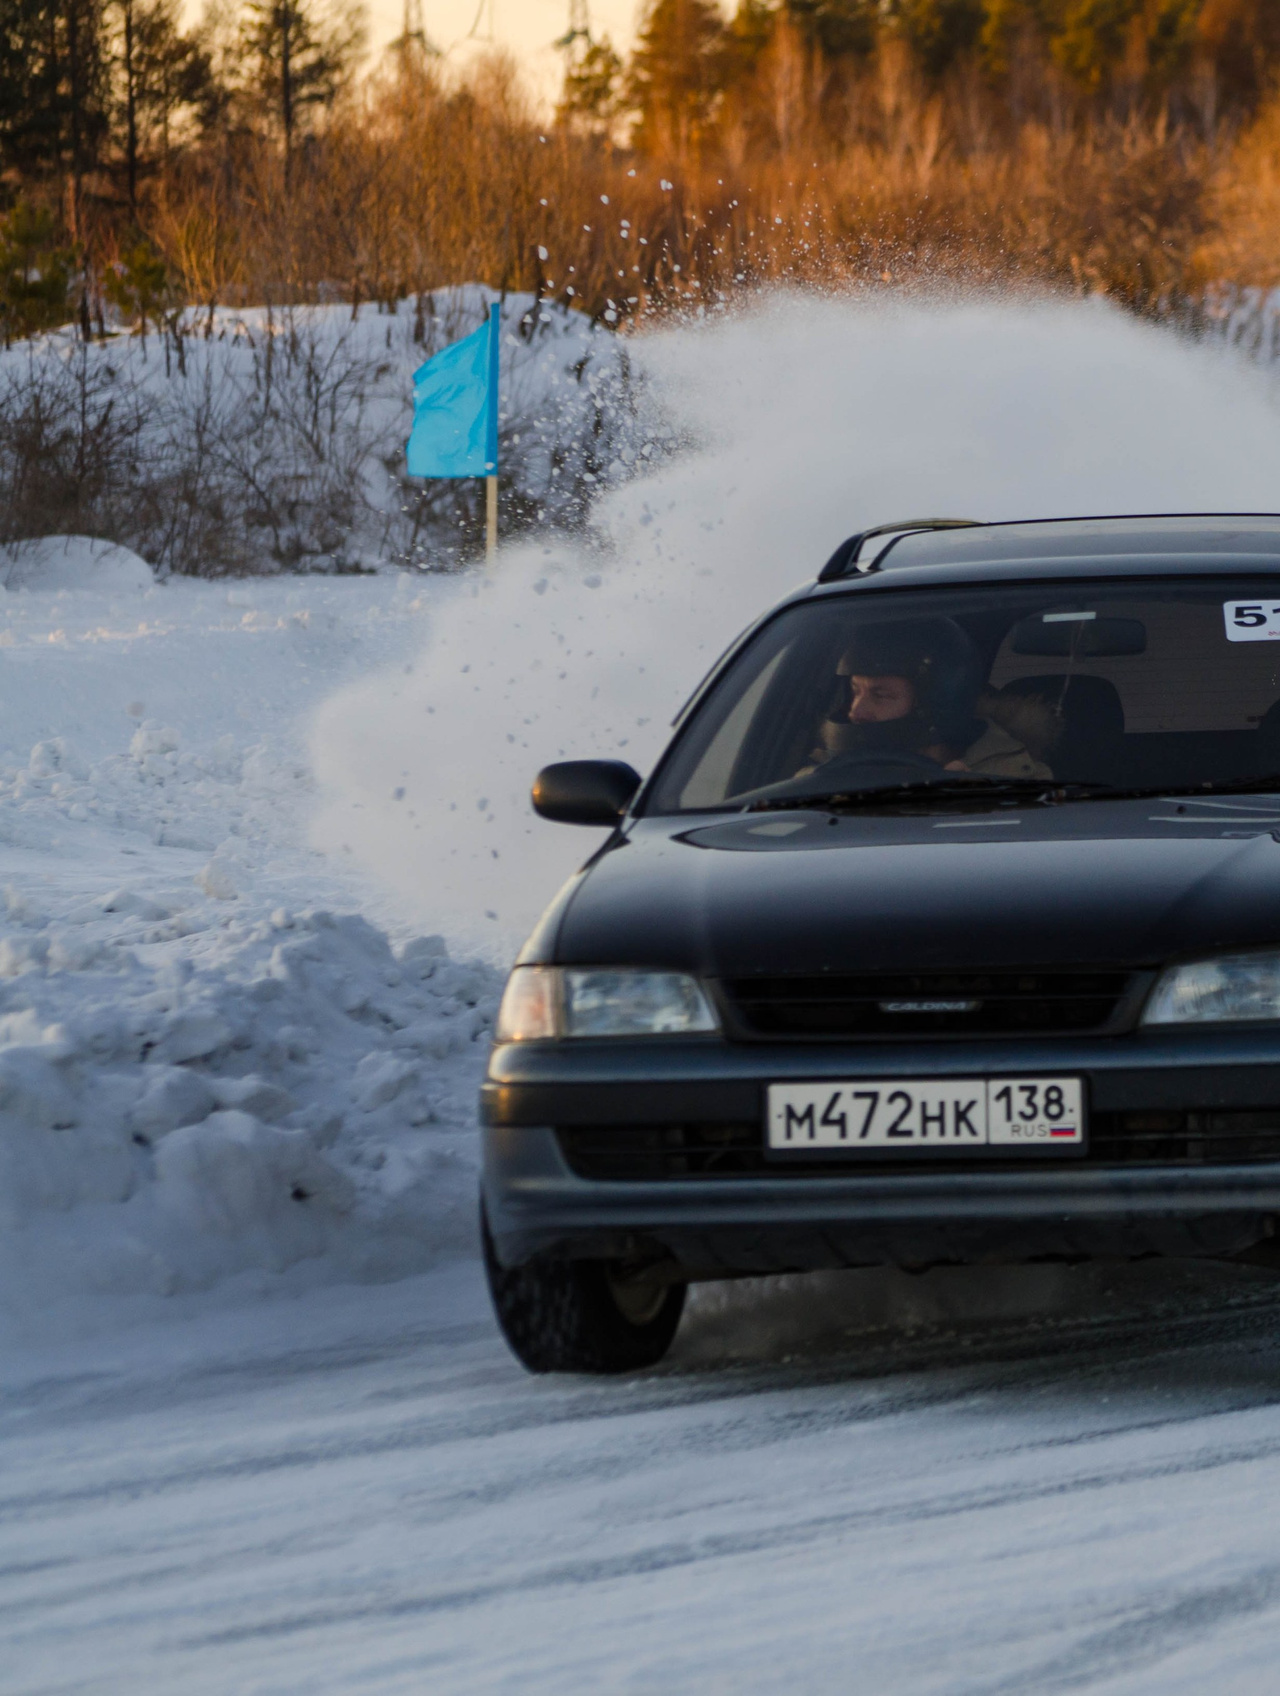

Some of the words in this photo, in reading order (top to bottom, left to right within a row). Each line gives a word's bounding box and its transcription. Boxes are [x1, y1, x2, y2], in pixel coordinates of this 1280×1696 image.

[887, 1001, 967, 1011] CALDINA
[994, 1085, 1065, 1123] 138
[1010, 1124, 1048, 1138] RUS
